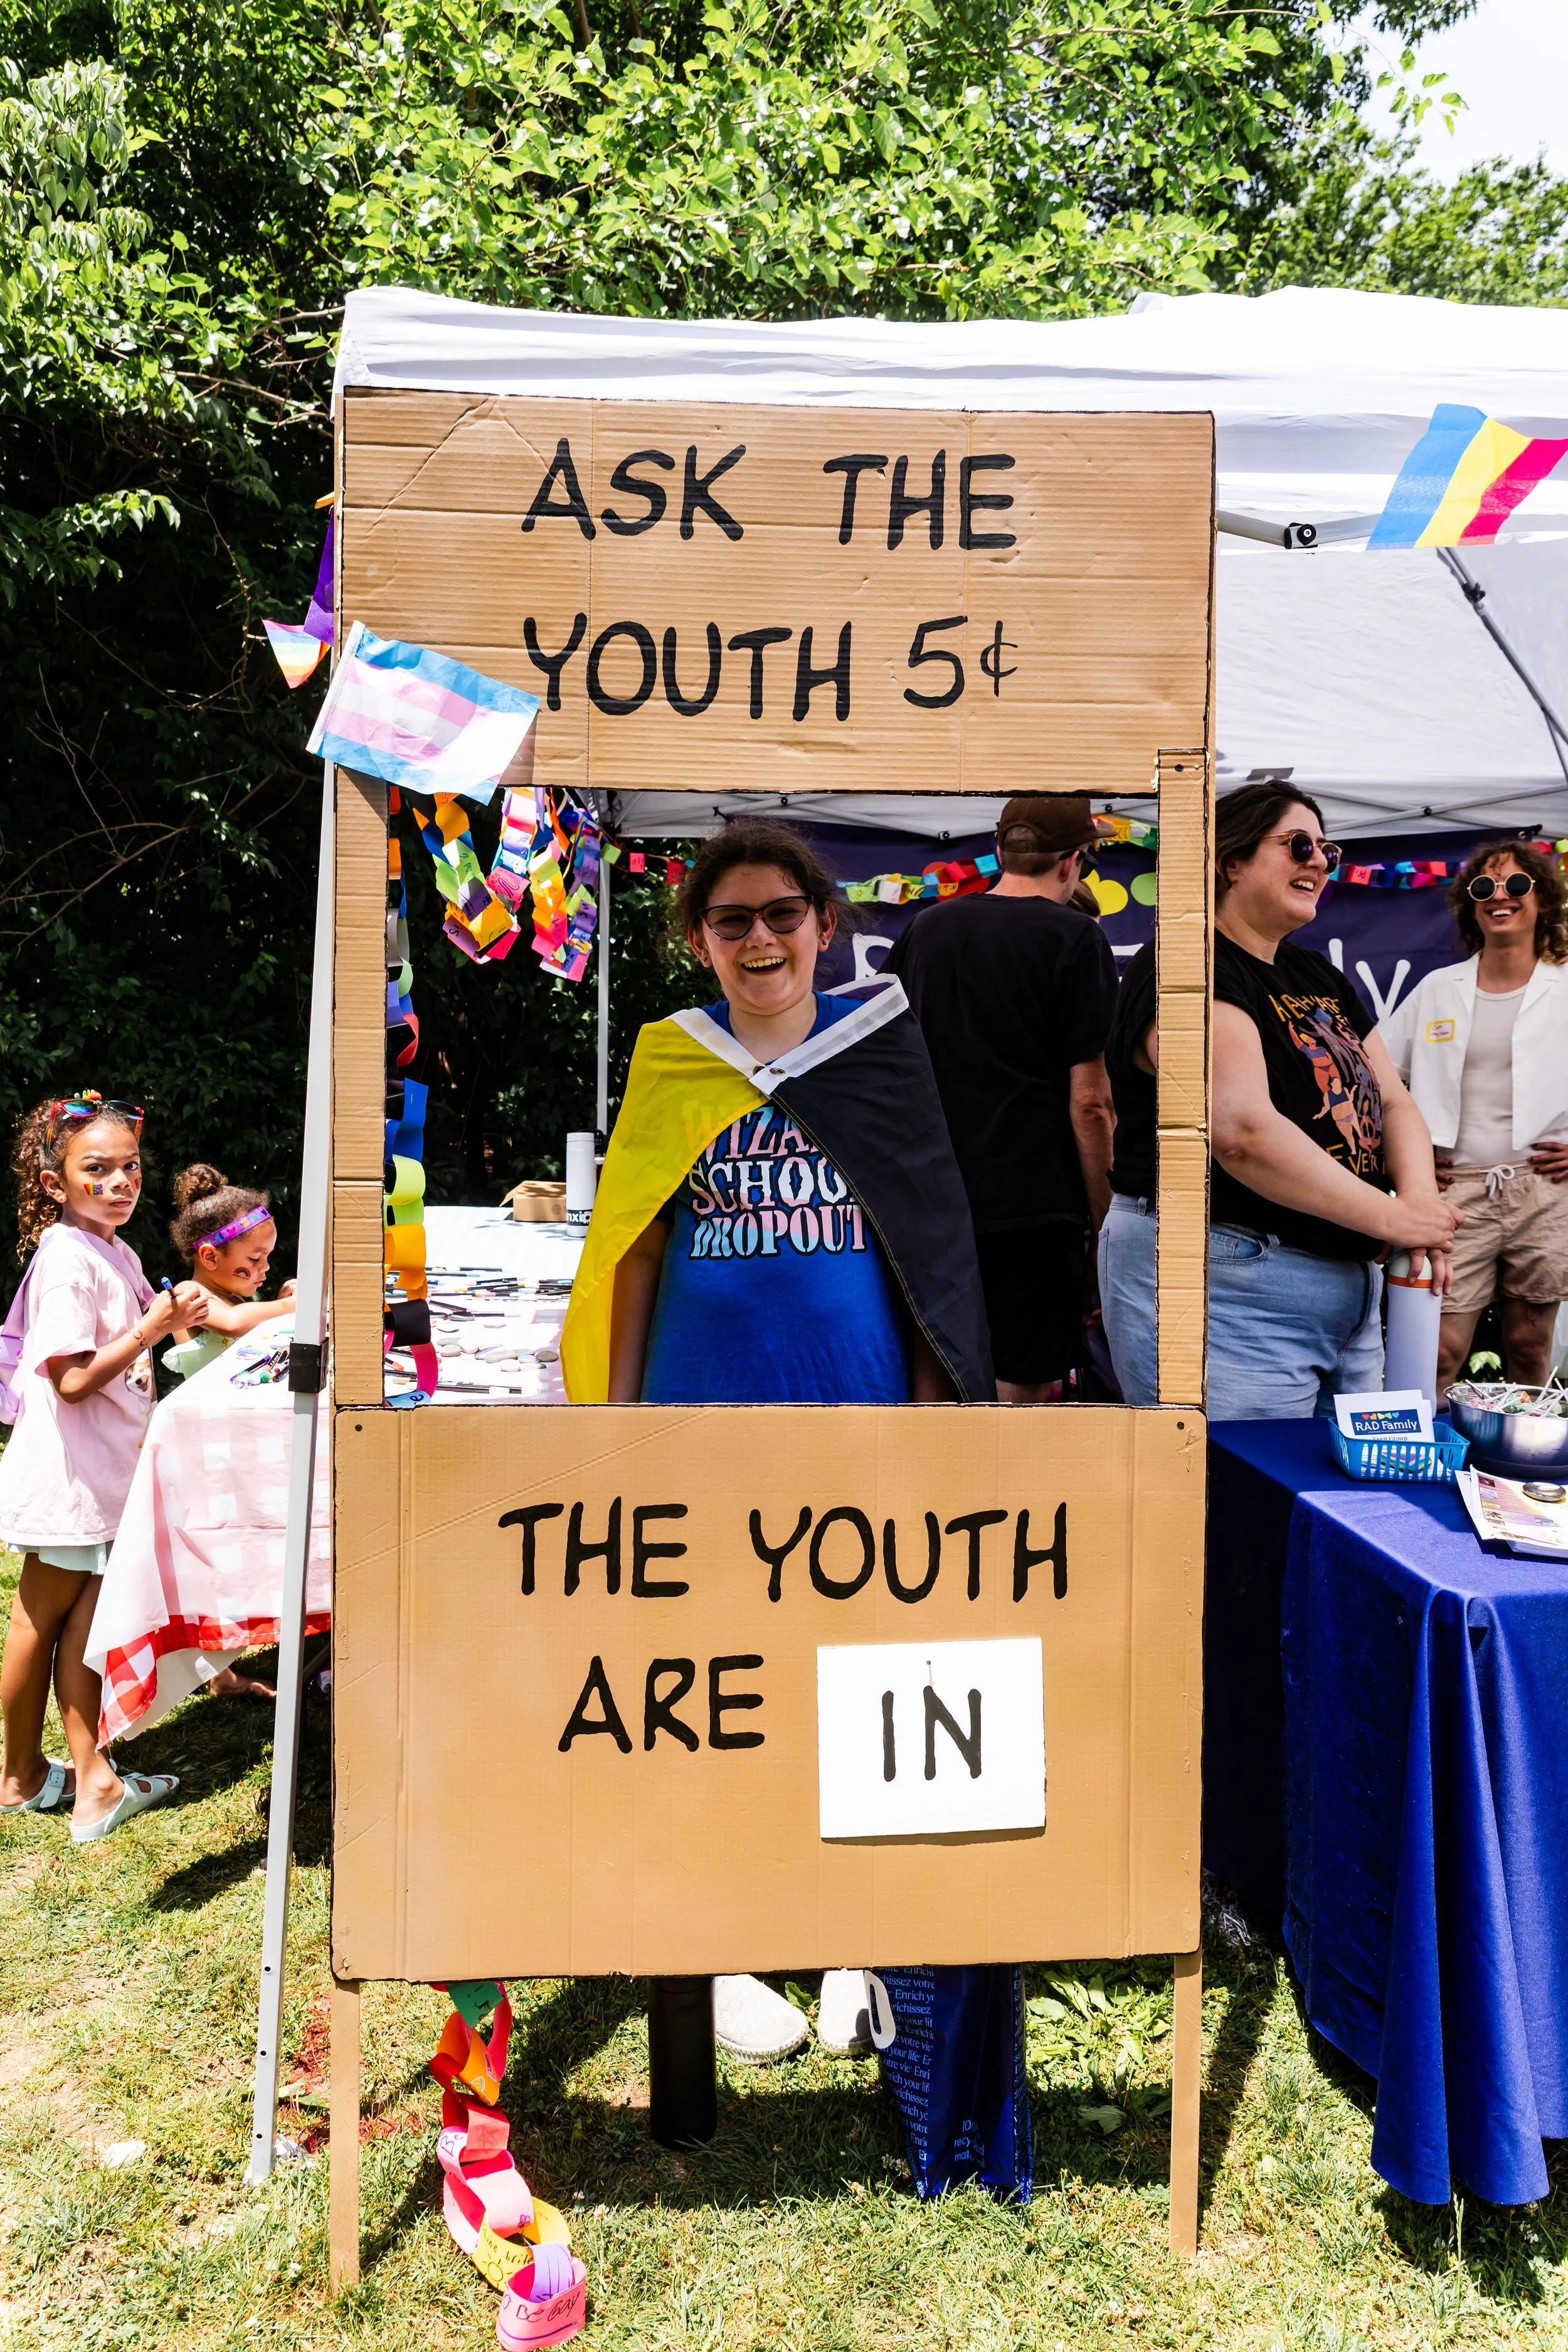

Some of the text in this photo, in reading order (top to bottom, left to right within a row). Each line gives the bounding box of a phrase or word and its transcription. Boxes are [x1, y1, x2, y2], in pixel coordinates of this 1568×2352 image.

[521, 438, 1017, 551] ASK THE
[523, 612, 852, 722] YOUTH
[689, 1157, 859, 1216] SCHOO
[691, 1205, 866, 1257] DROPOUT
[1355, 1419, 1417, 1431] RAD Family
[498, 1496, 1068, 1603] THE YOUTH
[558, 1654, 982, 1782] ARE IN
[895, 1989, 925, 2001] Enrich
[889, 2047, 908, 2058] your
[901, 2036, 920, 2048] votre
[903, 2078, 921, 2088] your
[954, 2137, 985, 2156] recycled
